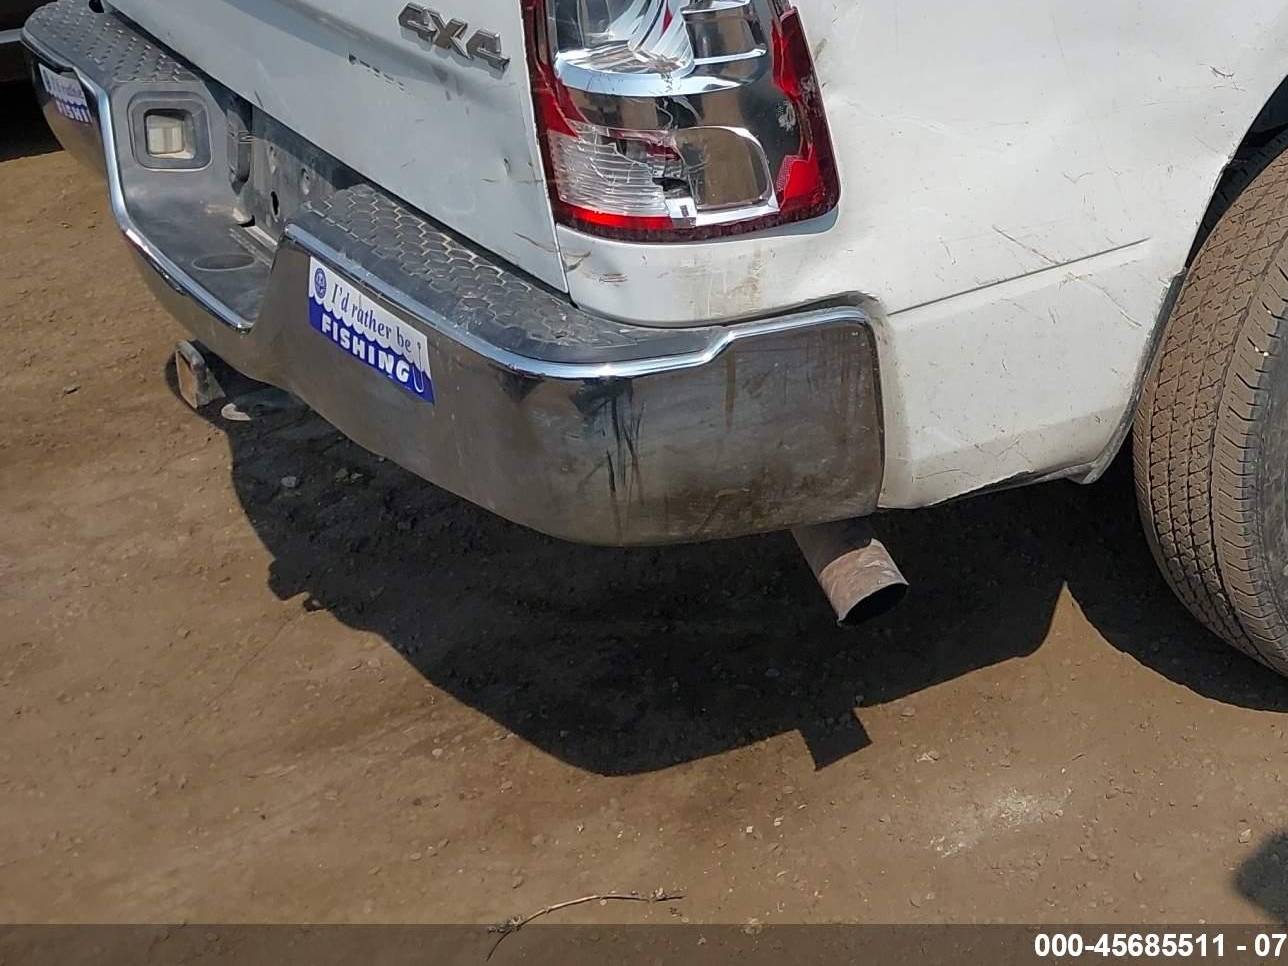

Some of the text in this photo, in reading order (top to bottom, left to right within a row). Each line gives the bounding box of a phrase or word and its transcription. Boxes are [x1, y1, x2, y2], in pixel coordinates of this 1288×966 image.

[321, 314, 410, 383] FISHING
[352, 305, 392, 340] rather
[397, 325, 412, 354] be
